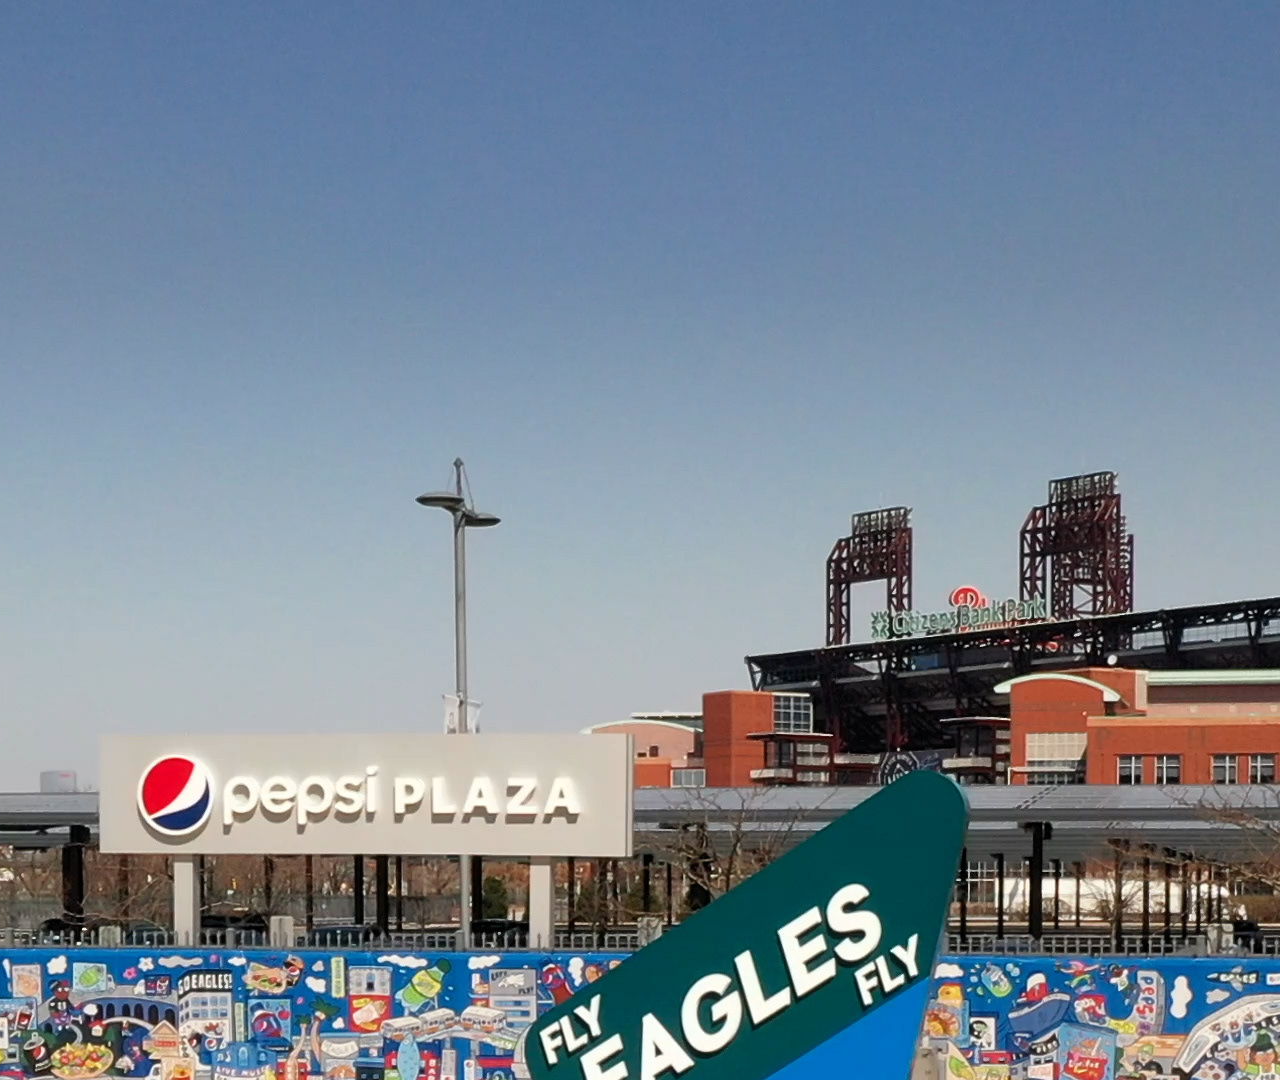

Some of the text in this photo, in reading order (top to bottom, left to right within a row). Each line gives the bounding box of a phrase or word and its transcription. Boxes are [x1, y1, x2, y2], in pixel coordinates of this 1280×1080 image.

[893, 609, 956, 635] Citizens
[959, 600, 1003, 627] Bank
[1006, 593, 1047, 622] Park
[223, 765, 582, 828] pepsi PLAZA
[855, 934, 920, 1007] FLY
[539, 994, 603, 1065] FLY
